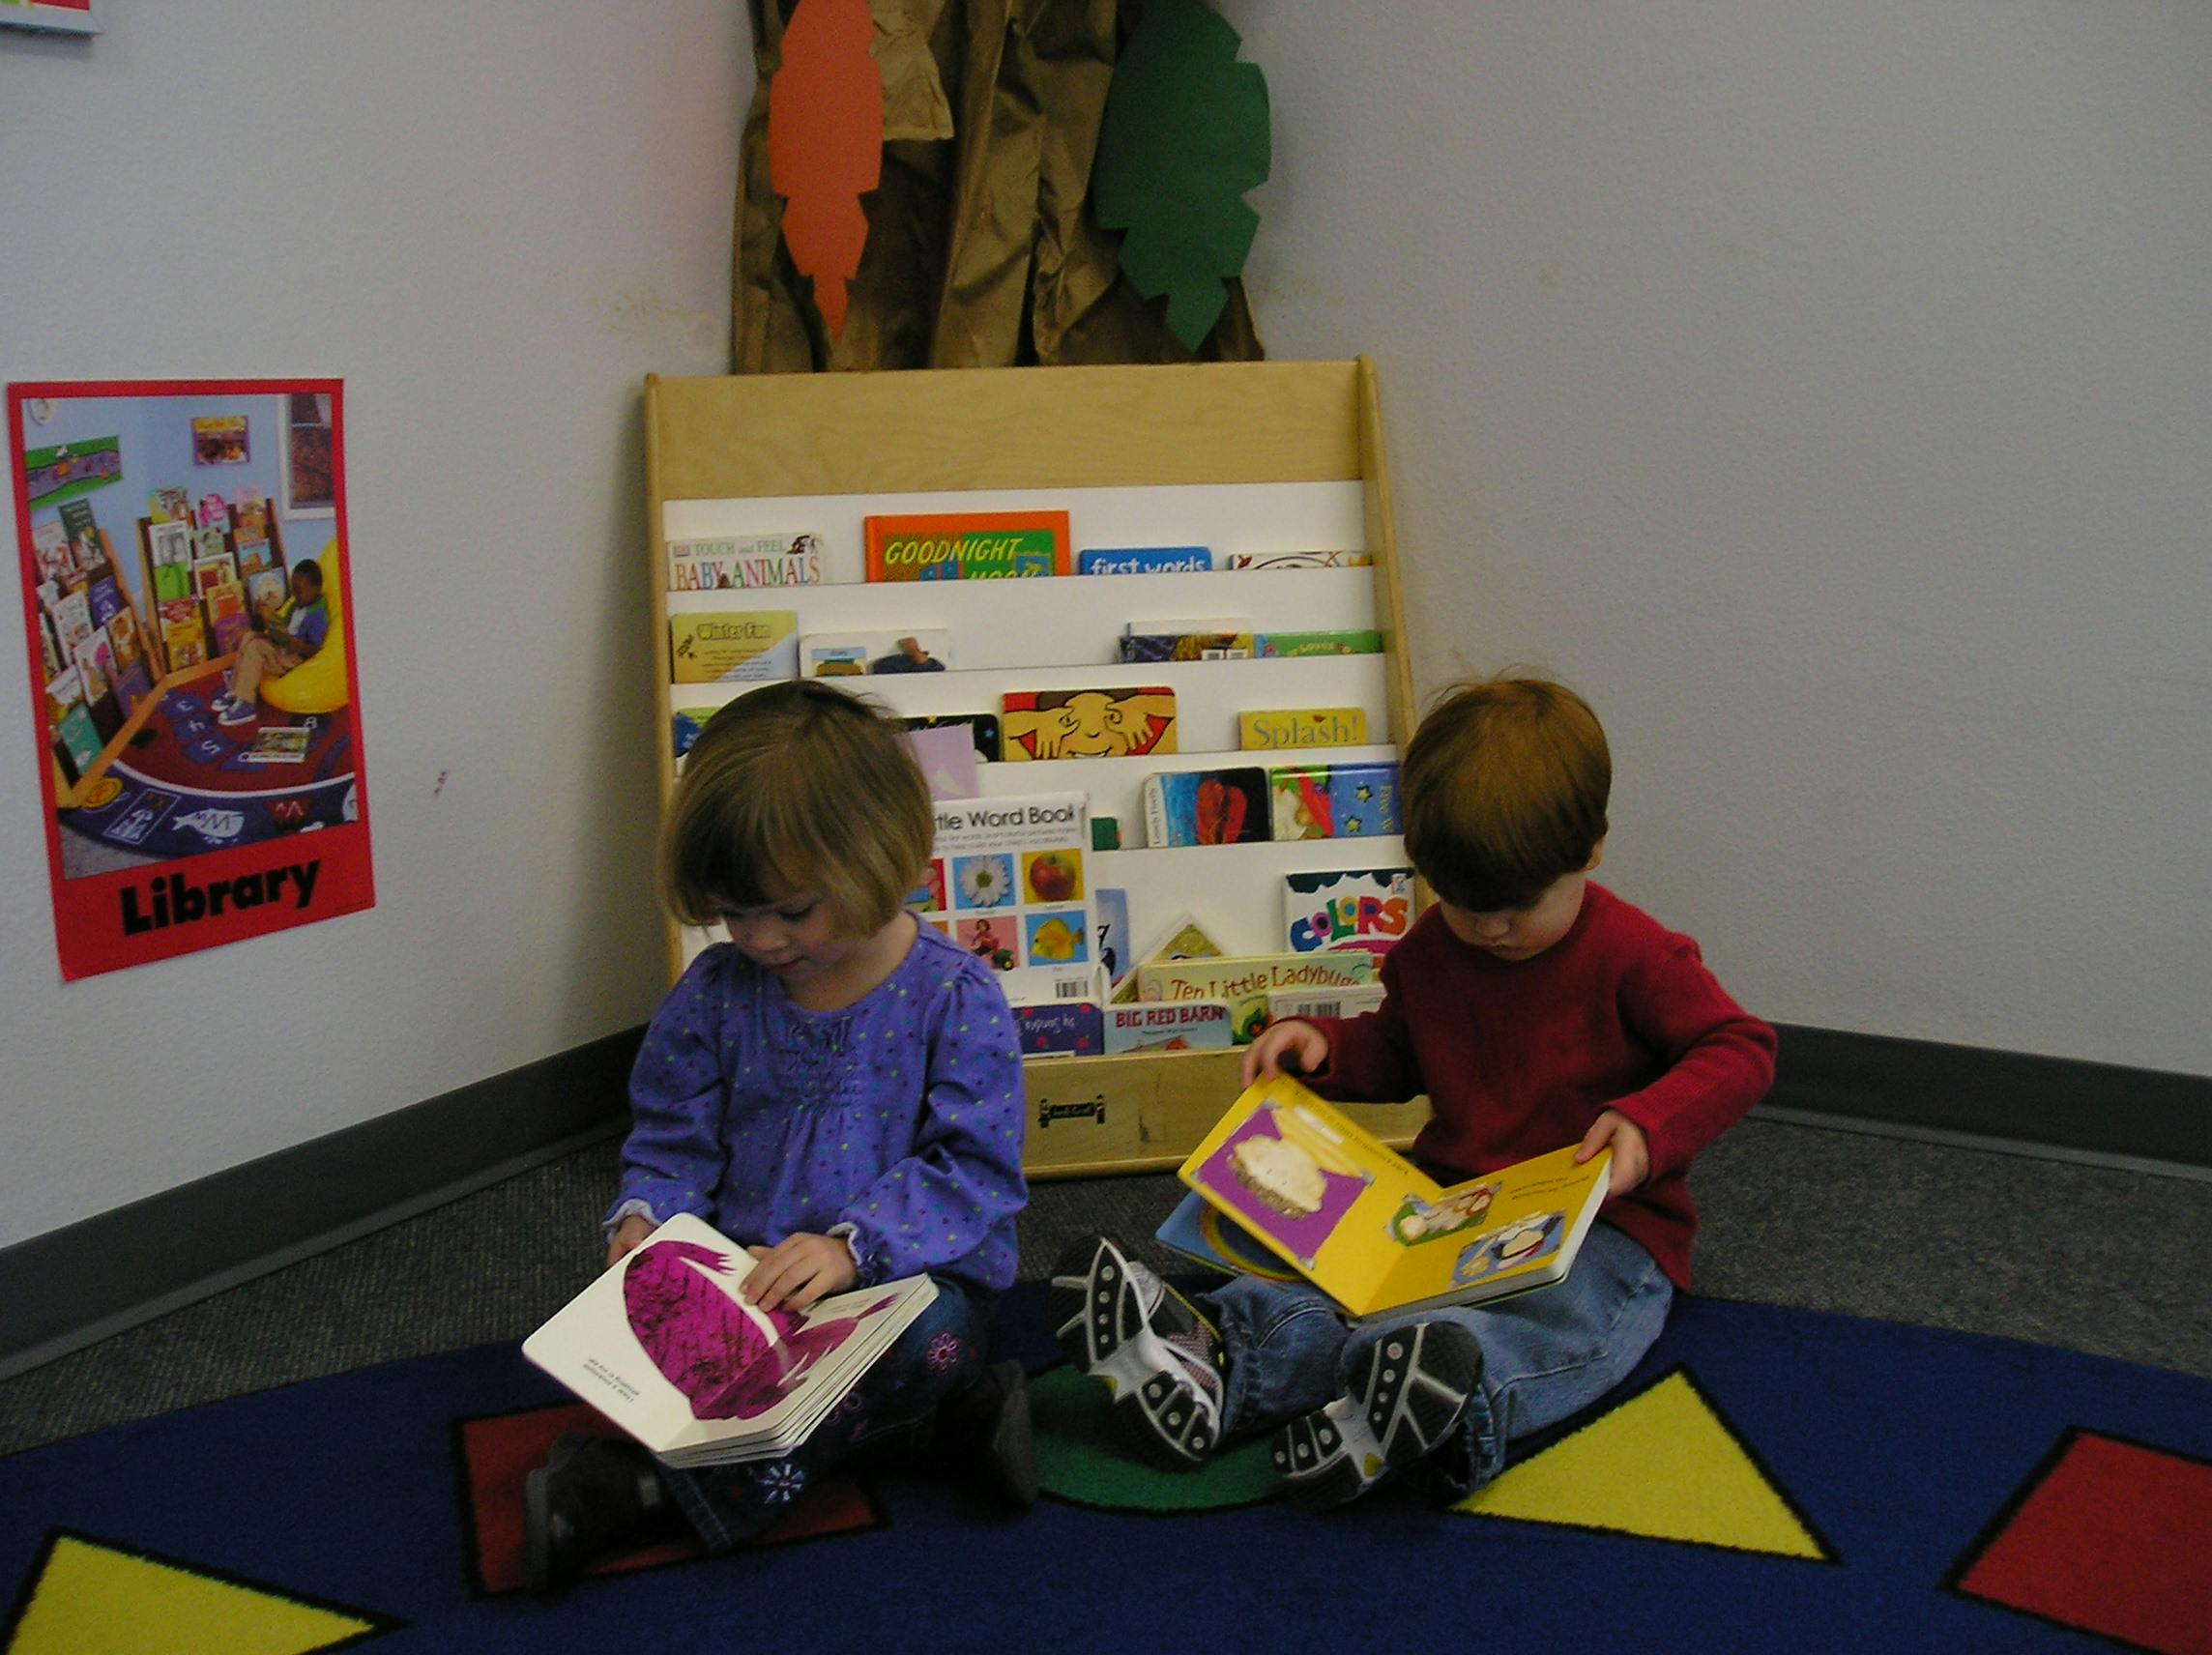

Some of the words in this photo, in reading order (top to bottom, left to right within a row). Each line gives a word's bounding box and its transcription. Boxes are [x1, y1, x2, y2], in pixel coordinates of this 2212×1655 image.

[694, 539, 735, 556] TOUCH
[757, 538, 785, 553] FEEL
[885, 537, 1024, 565] GOODNIGHT
[674, 560, 724, 591] BABY
[732, 556, 821, 590] ANIMALS
[1091, 557, 1140, 575] first
[1145, 555, 1207, 573] words
[1253, 713, 1359, 749] Splash!
[967, 806, 1025, 828] Word
[1029, 803, 1075, 825] Book
[120, 861, 321, 936] Library
[1290, 895, 1409, 952] COLORS
[1171, 978, 1205, 1001] Ten
[1209, 973, 1268, 1000] Little
[1115, 1010, 1143, 1029] BIG
[1146, 1008, 1177, 1027] RED
[1179, 1005, 1226, 1025] BARN
